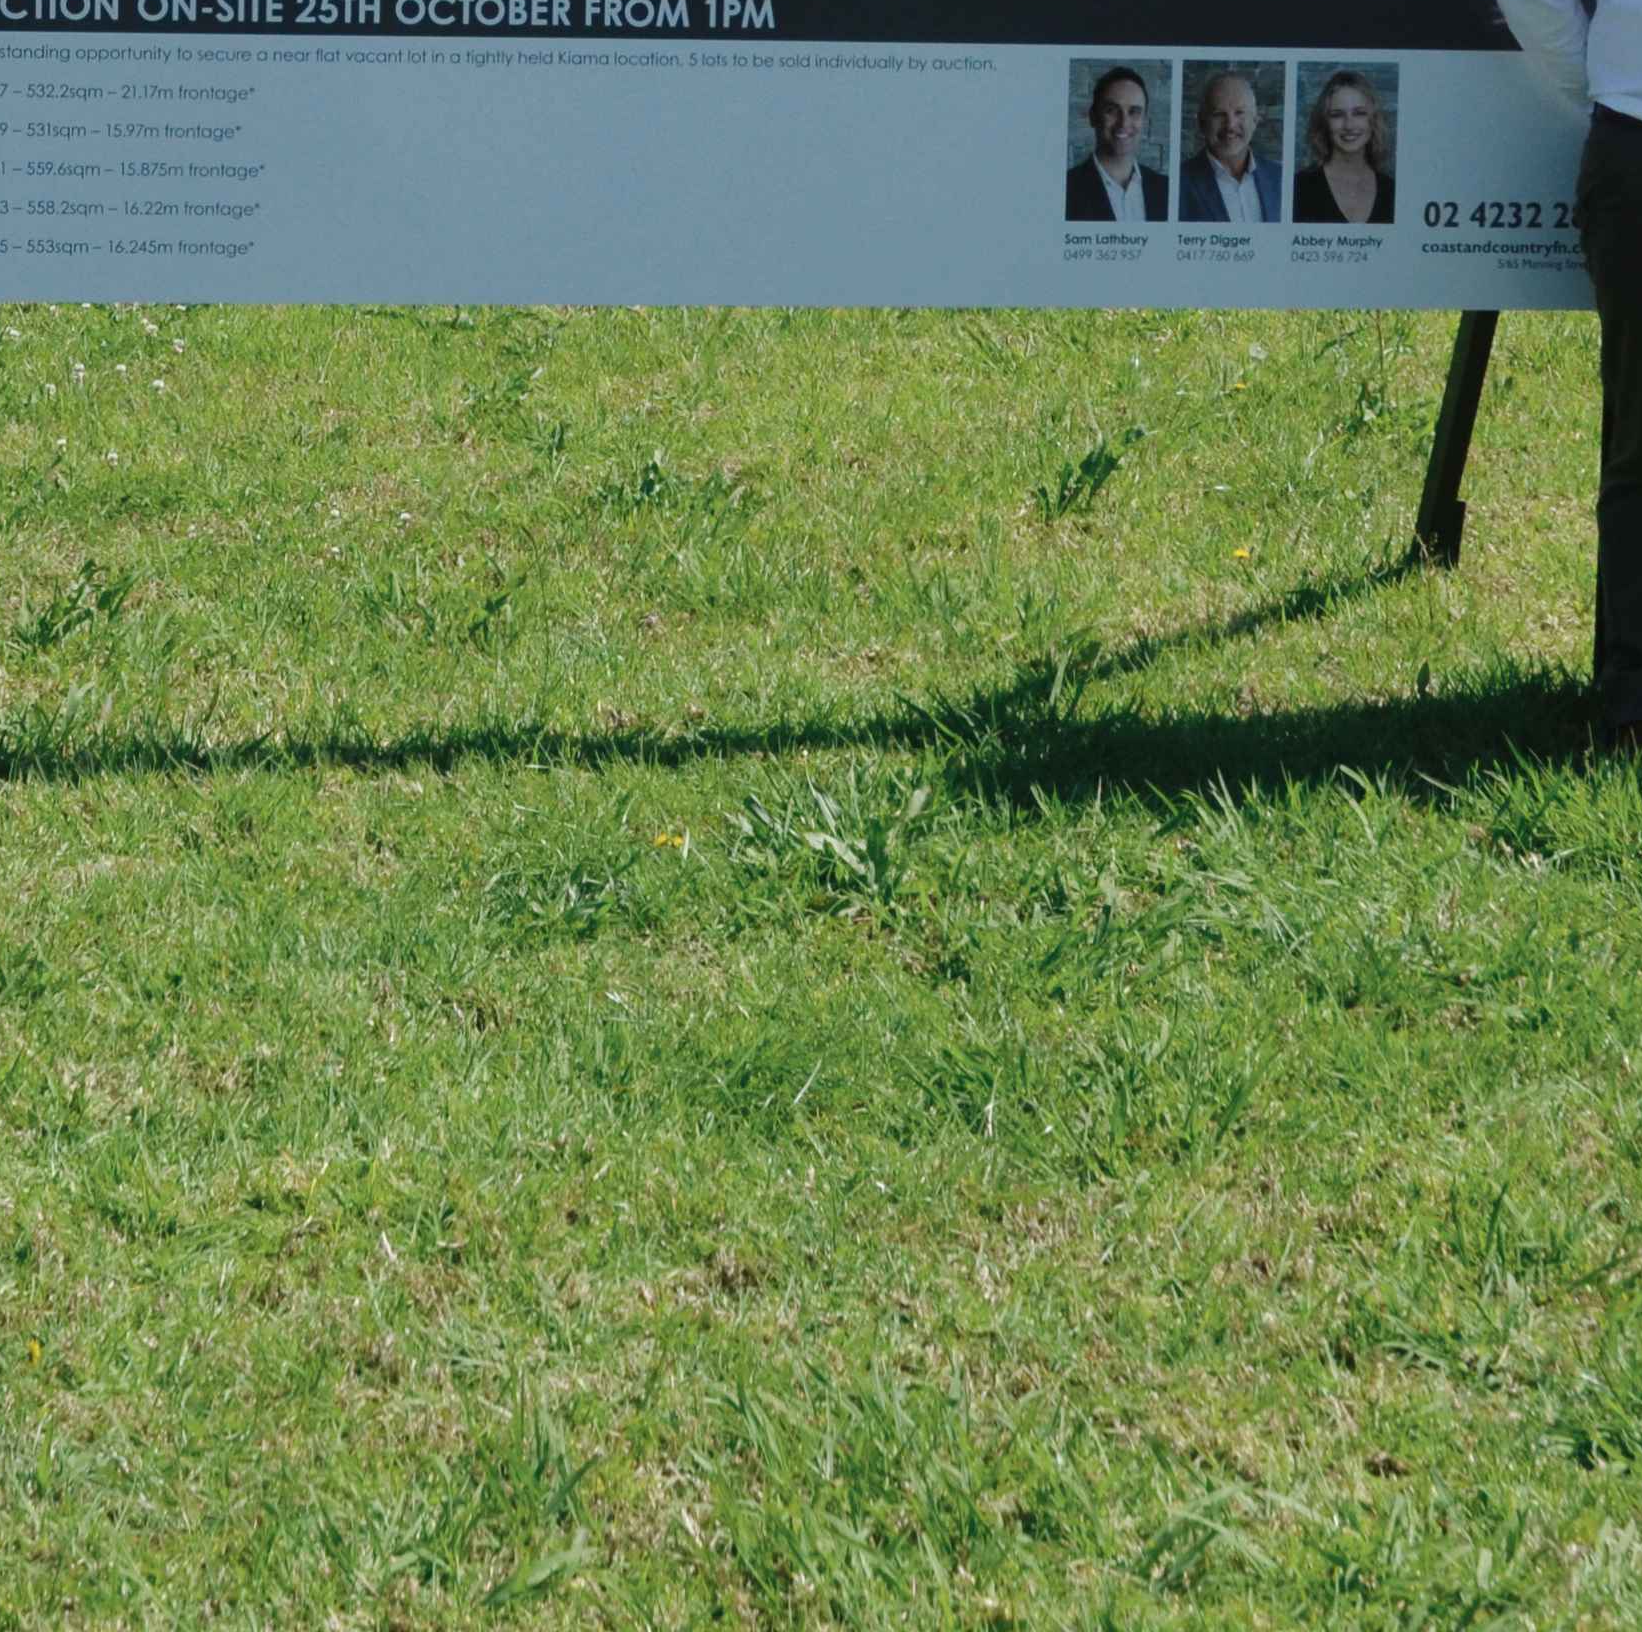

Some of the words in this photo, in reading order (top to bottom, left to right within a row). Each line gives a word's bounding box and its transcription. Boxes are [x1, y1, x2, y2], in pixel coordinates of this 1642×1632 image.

[75, 45, 172, 64] opportunity
[177, 47, 193, 61] to
[197, 50, 252, 62] secure
[256, 50, 268, 63] a
[273, 50, 310, 63] near
[315, 47, 340, 63] flat
[345, 49, 403, 64] vacant
[407, 48, 427, 64] lot
[431, 49, 445, 64] in
[450, 52, 461, 65] a
[465, 50, 514, 68] tightly
[517, 51, 554, 66] held
[557, 51, 610, 66] Kiama
[613, 51, 681, 67] location.
[689, 52, 698, 67] 5
[701, 52, 728, 67] lots
[733, 53, 748, 68] to
[752, 54, 774, 69] be
[779, 53, 809, 69] sold
[814, 54, 904, 72] individually
[908, 55, 926, 72] by
[932, 55, 998, 71] auction.
[25, 83, 103, 102] 532.2sqm
[121, 84, 173, 99] 21.17m
[25, 122, 87, 141] 531sqm
[105, 123, 159, 138] 15.97m
[26, 161, 101, 179] 559.6sqm
[120, 162, 184, 177] 15.875m
[27, 200, 104, 219] 558.2sqm
[124, 201, 179, 216] 16.22m
[1423, 201, 1459, 228] 02
[1469, 201, 1543, 229] 4232
[25, 239, 89, 258] 553sqm
[108, 239, 173, 255] 16.245m
[1064, 233, 1093, 246] Sam
[1095, 233, 1149, 248] Lathbury
[1177, 234, 1207, 248] Terry
[1210, 234, 1252, 249] Digger
[1292, 235, 1334, 249] Abbey
[1336, 235, 1384, 249] Murphy
[1421, 239, 1581, 258] coastandcountryfn.c
